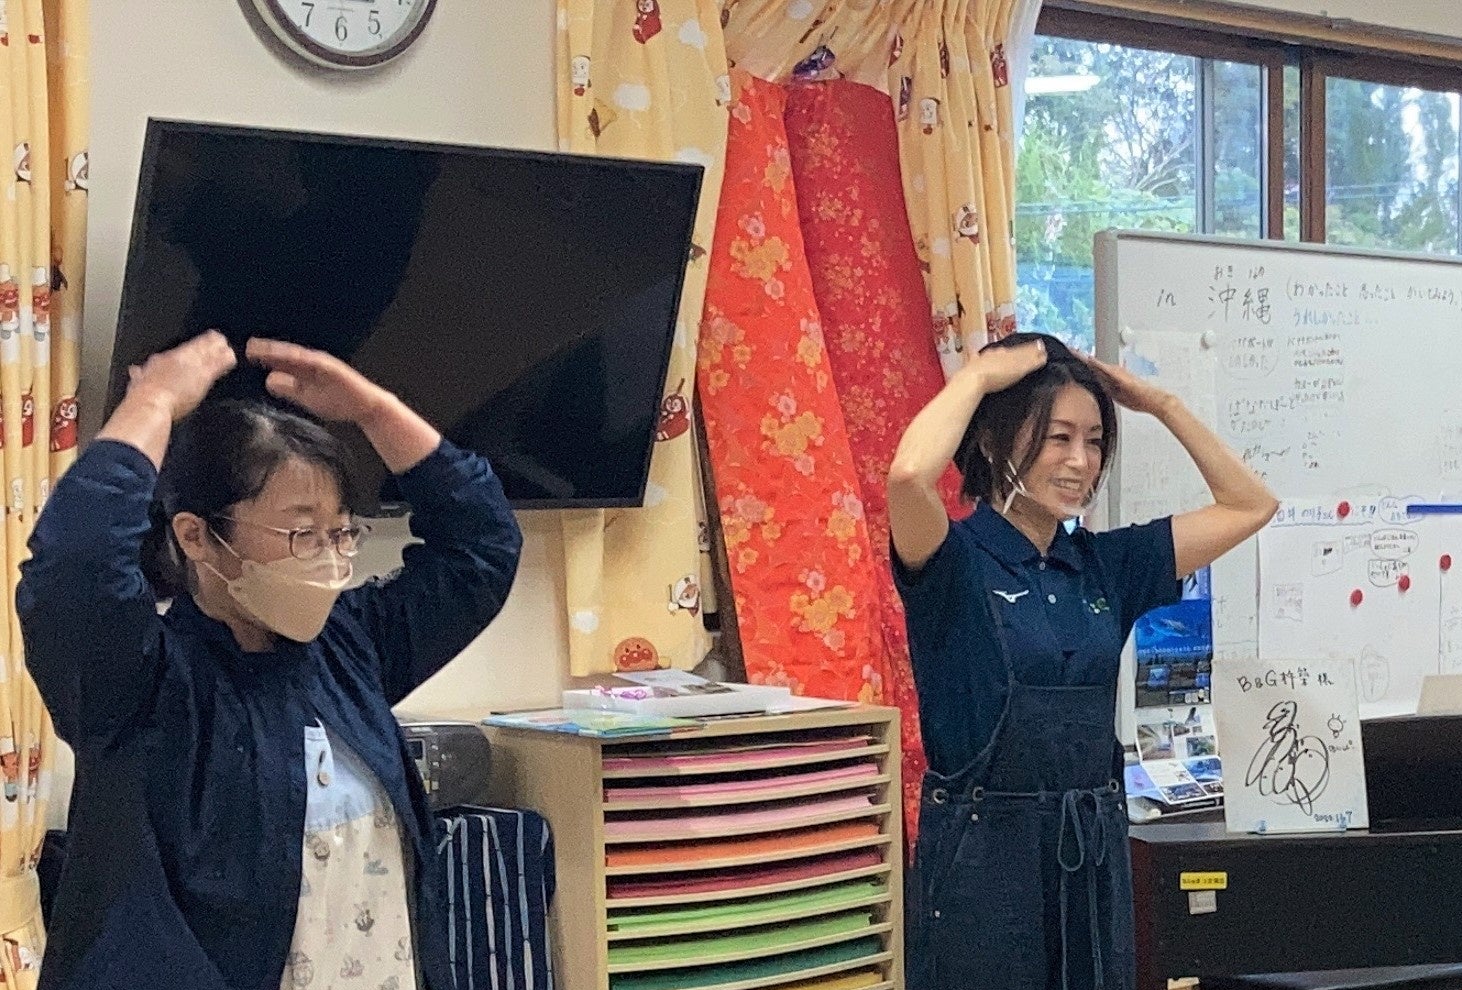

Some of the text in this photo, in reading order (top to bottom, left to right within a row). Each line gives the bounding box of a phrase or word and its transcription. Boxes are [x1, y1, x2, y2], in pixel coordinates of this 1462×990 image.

[301, 3, 315, 27] 7
[367, 10, 381, 36] 5
[334, 15, 348, 42] 6
[1207, 283, 1272, 325] 沖縄
